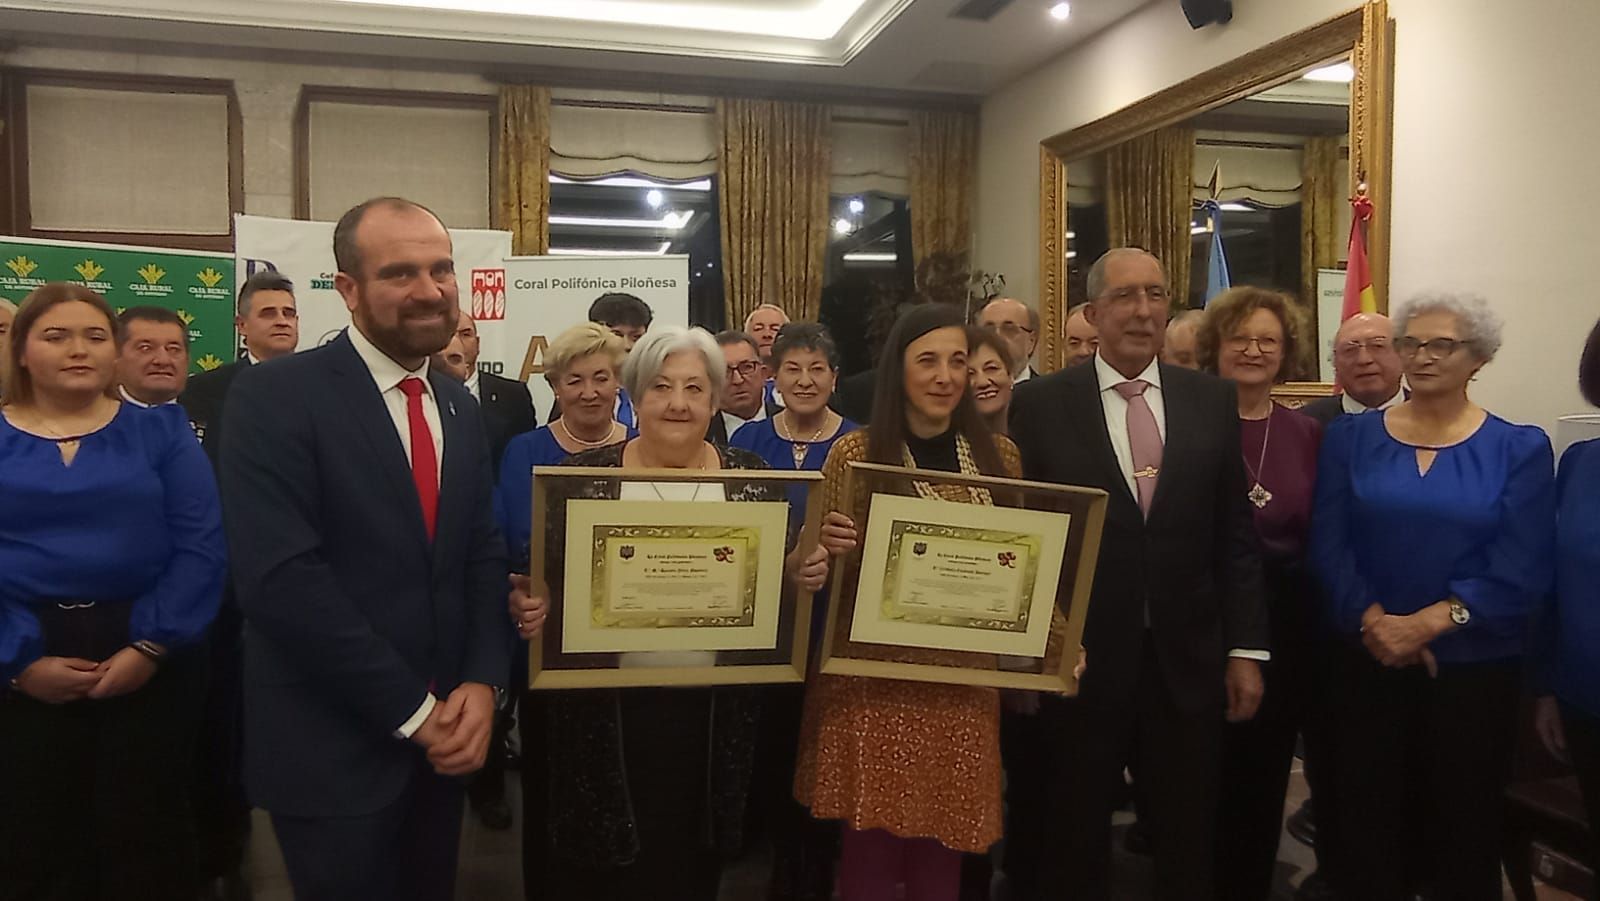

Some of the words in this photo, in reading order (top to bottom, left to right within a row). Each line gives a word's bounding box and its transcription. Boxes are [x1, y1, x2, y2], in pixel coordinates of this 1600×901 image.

[514, 278, 548, 290] Coral
[551, 277, 617, 290] Polifónica
[620, 277, 677, 289] Piloñesa
